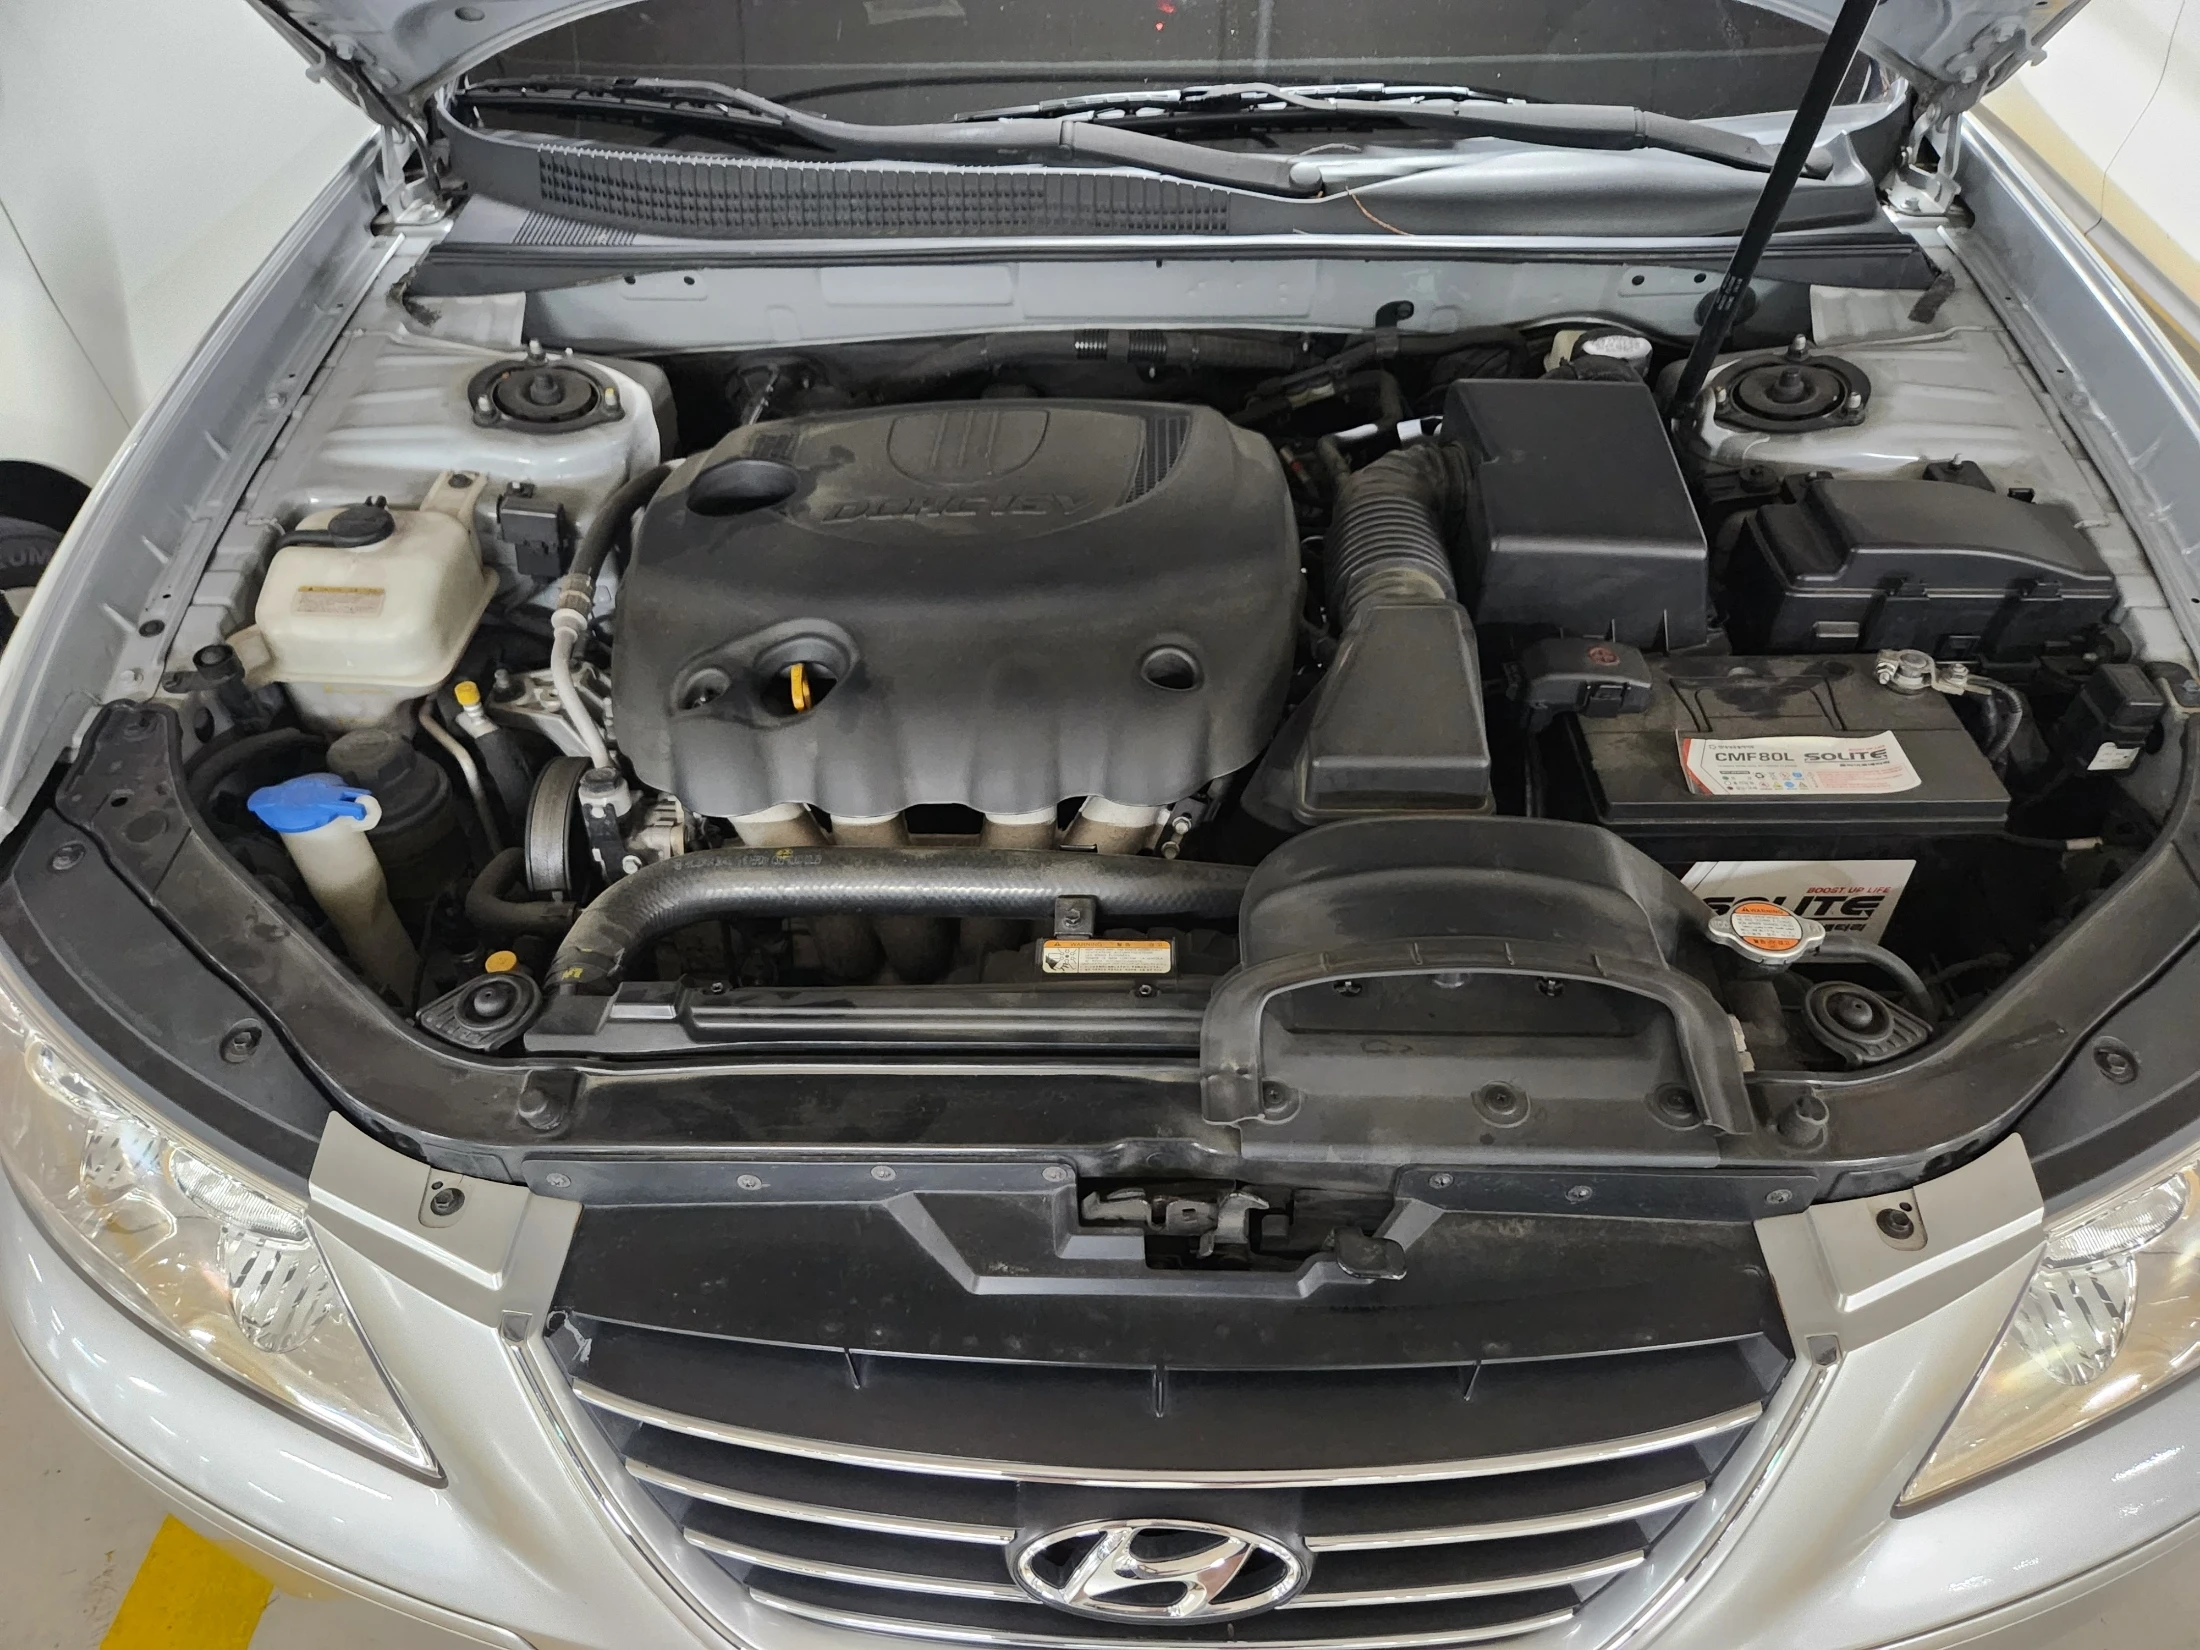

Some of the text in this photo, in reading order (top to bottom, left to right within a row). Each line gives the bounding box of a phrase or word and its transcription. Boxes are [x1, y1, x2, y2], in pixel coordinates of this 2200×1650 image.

[1714, 751, 1795, 762] CMF80L
[1803, 748, 1889, 761] SOLITE
[1806, 886, 1892, 894] BOOST UP LIFE
